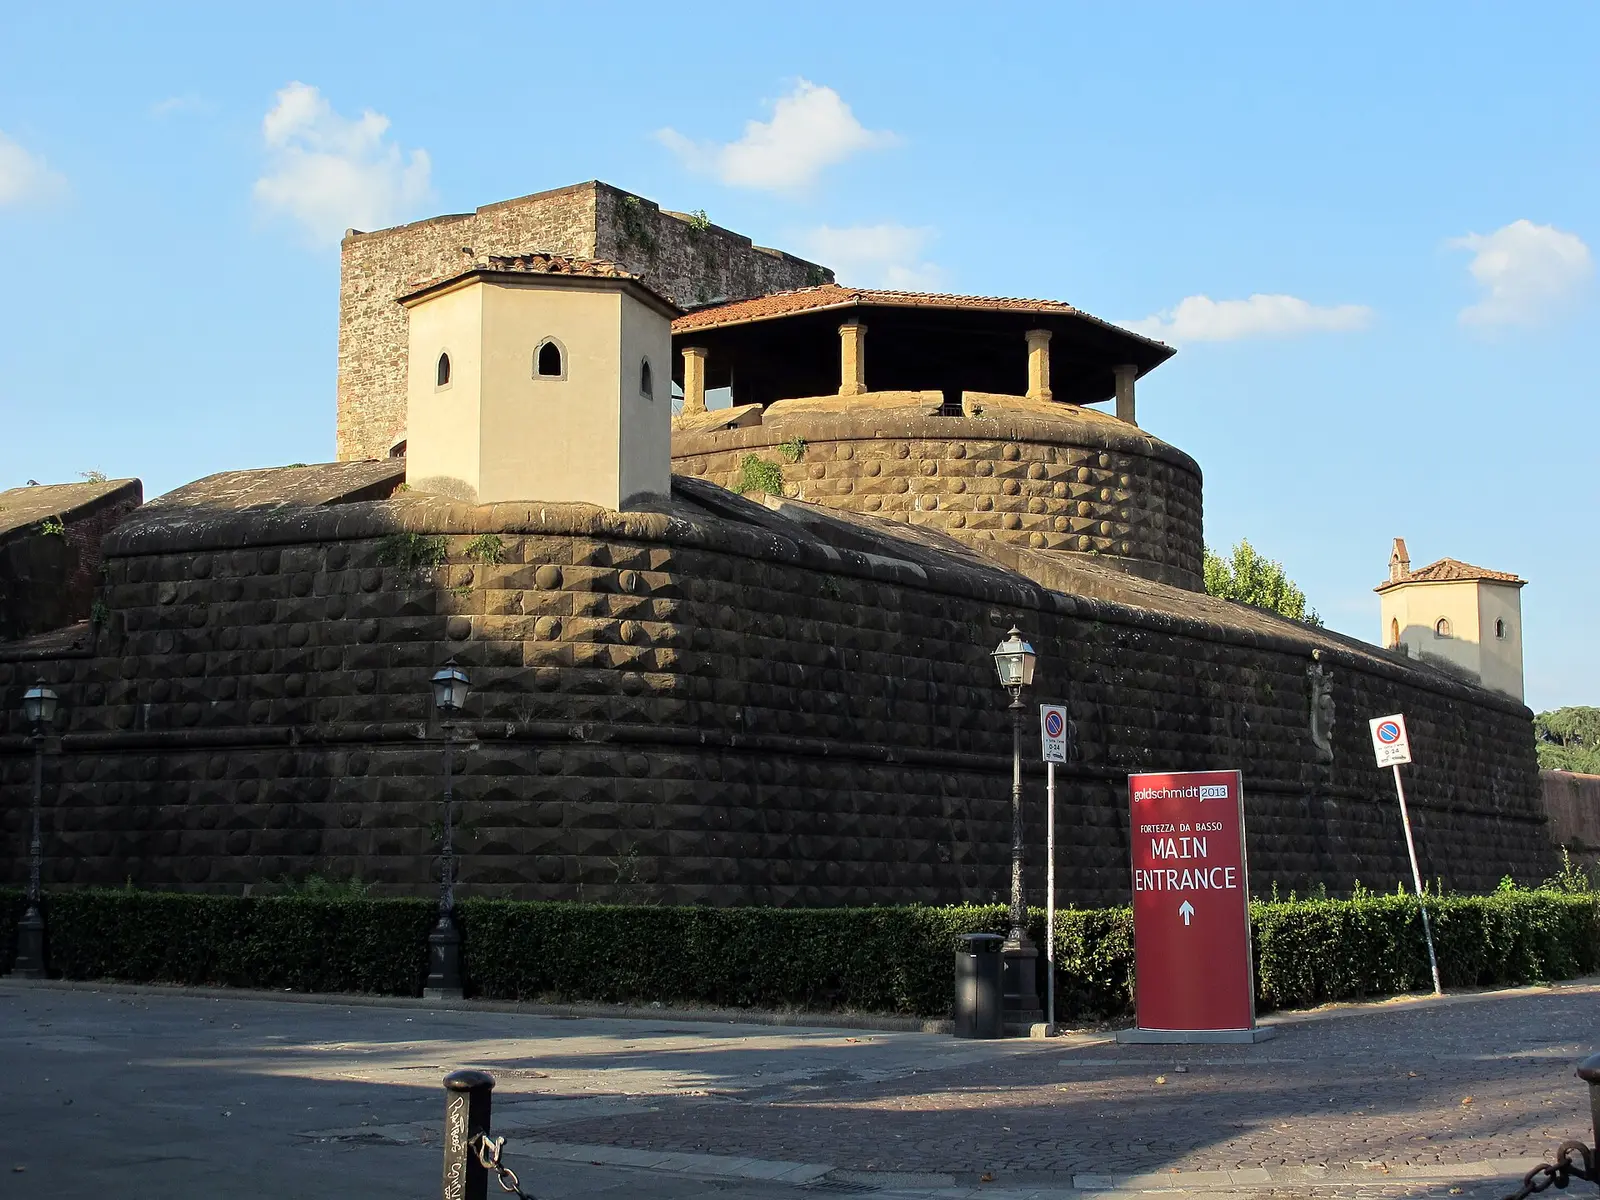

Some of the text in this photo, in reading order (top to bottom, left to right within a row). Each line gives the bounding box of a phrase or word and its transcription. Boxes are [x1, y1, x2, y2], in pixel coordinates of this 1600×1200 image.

[1134, 785, 1226, 802] goldschmidt 2013
[1140, 822, 1223, 833] FORTEZZA DA BASSO
[1151, 836, 1207, 859] MAIN
[1135, 867, 1237, 891] ENTRANCE
